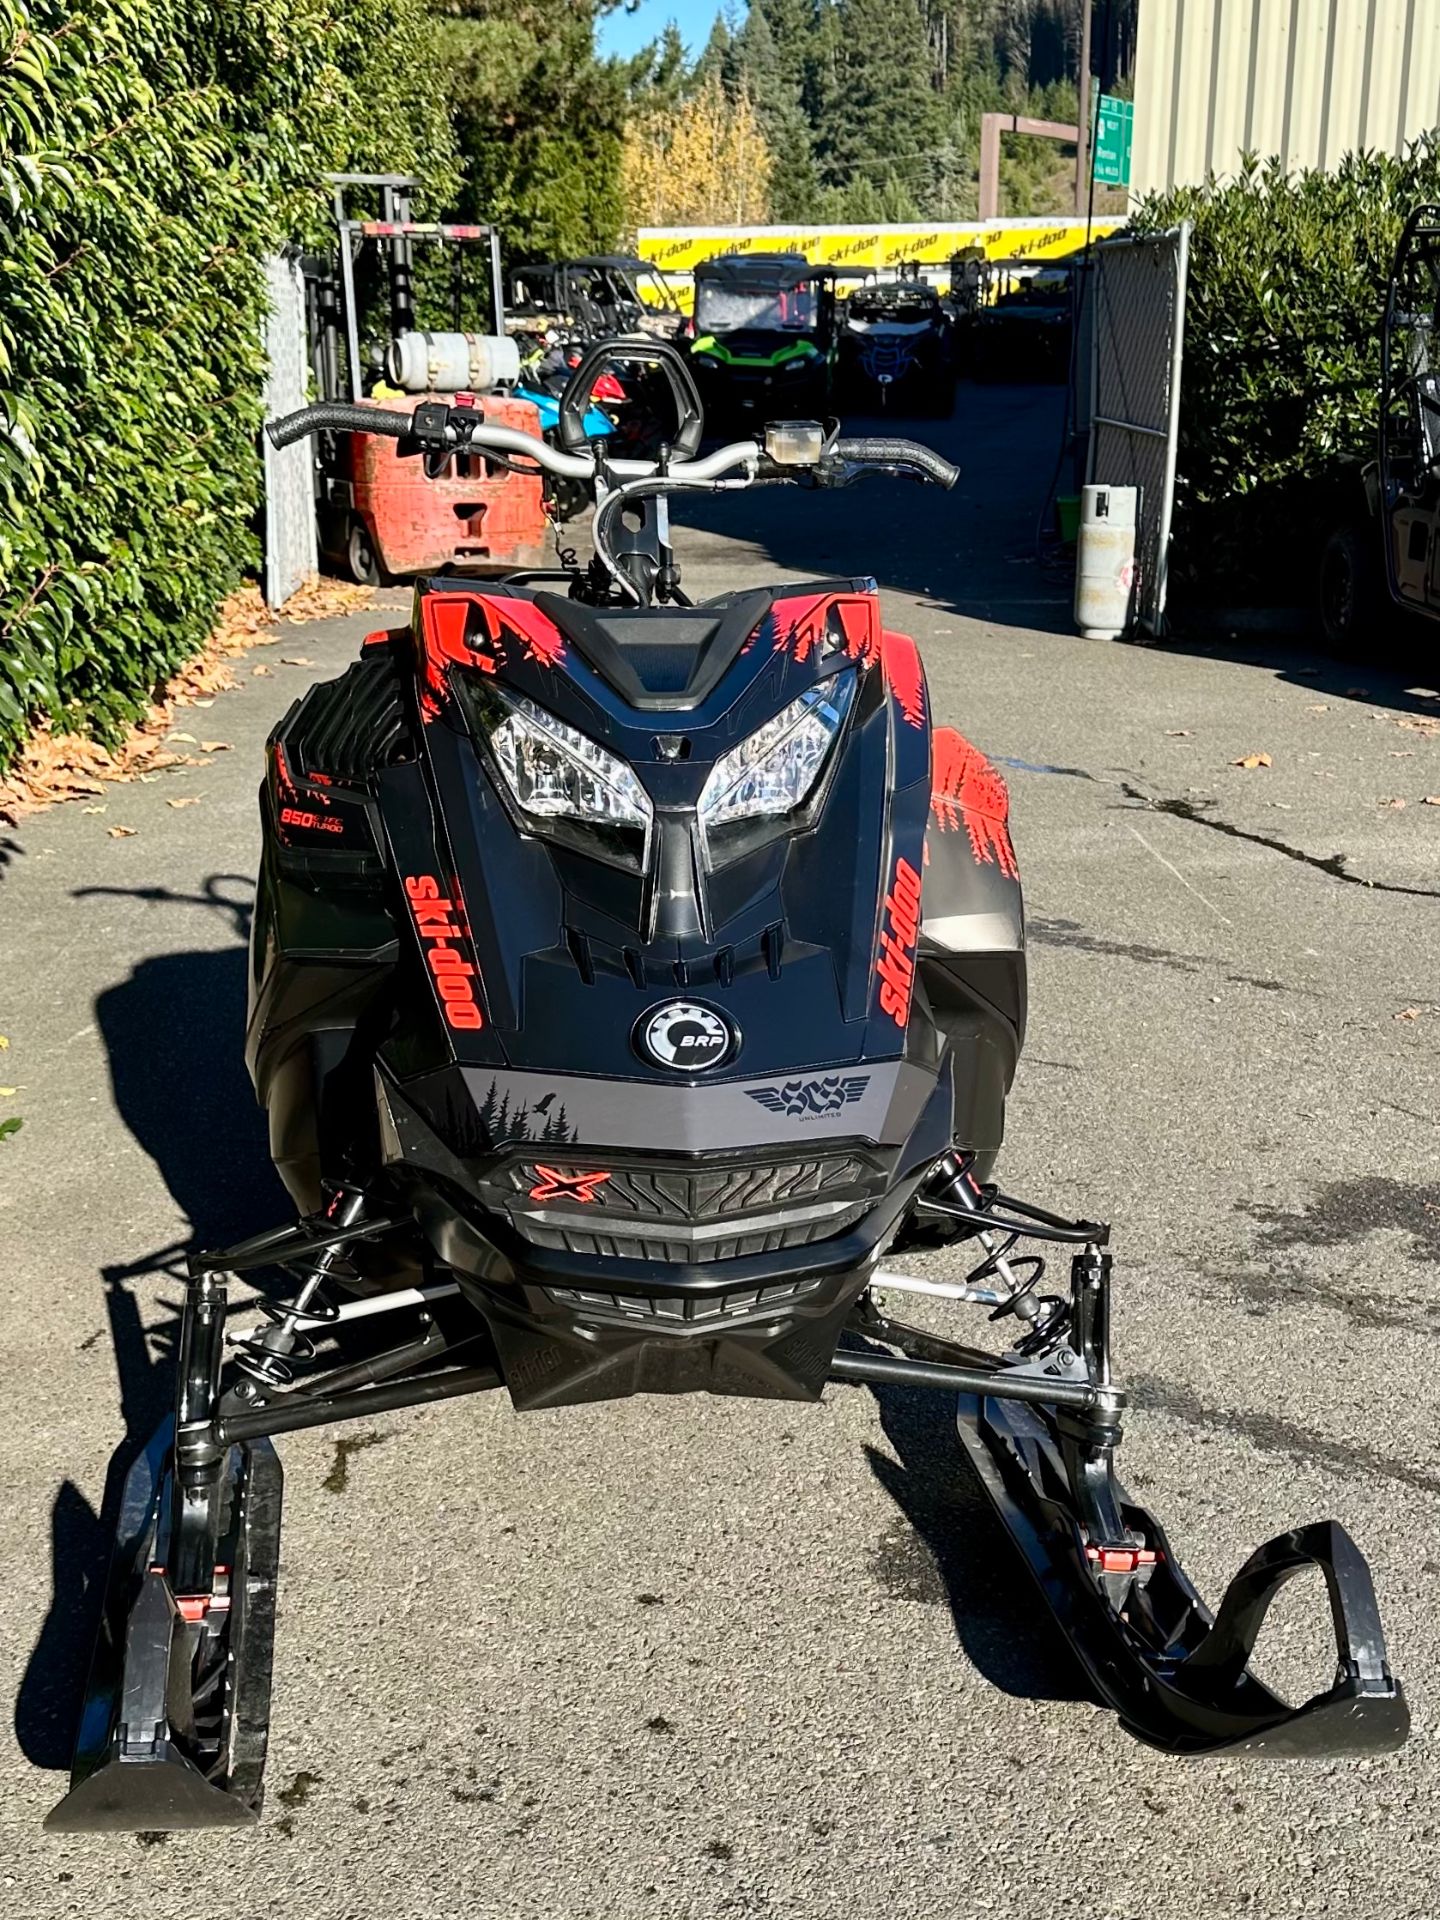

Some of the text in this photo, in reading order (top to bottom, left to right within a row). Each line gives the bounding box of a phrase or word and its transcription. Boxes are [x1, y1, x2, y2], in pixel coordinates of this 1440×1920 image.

[885, 233, 938, 264] ski-doo
[281, 808, 313, 828] 850
[405, 875, 482, 1030] ski-doo
[876, 857, 922, 1028] ski-doo
[679, 1035, 724, 1047] BRP
